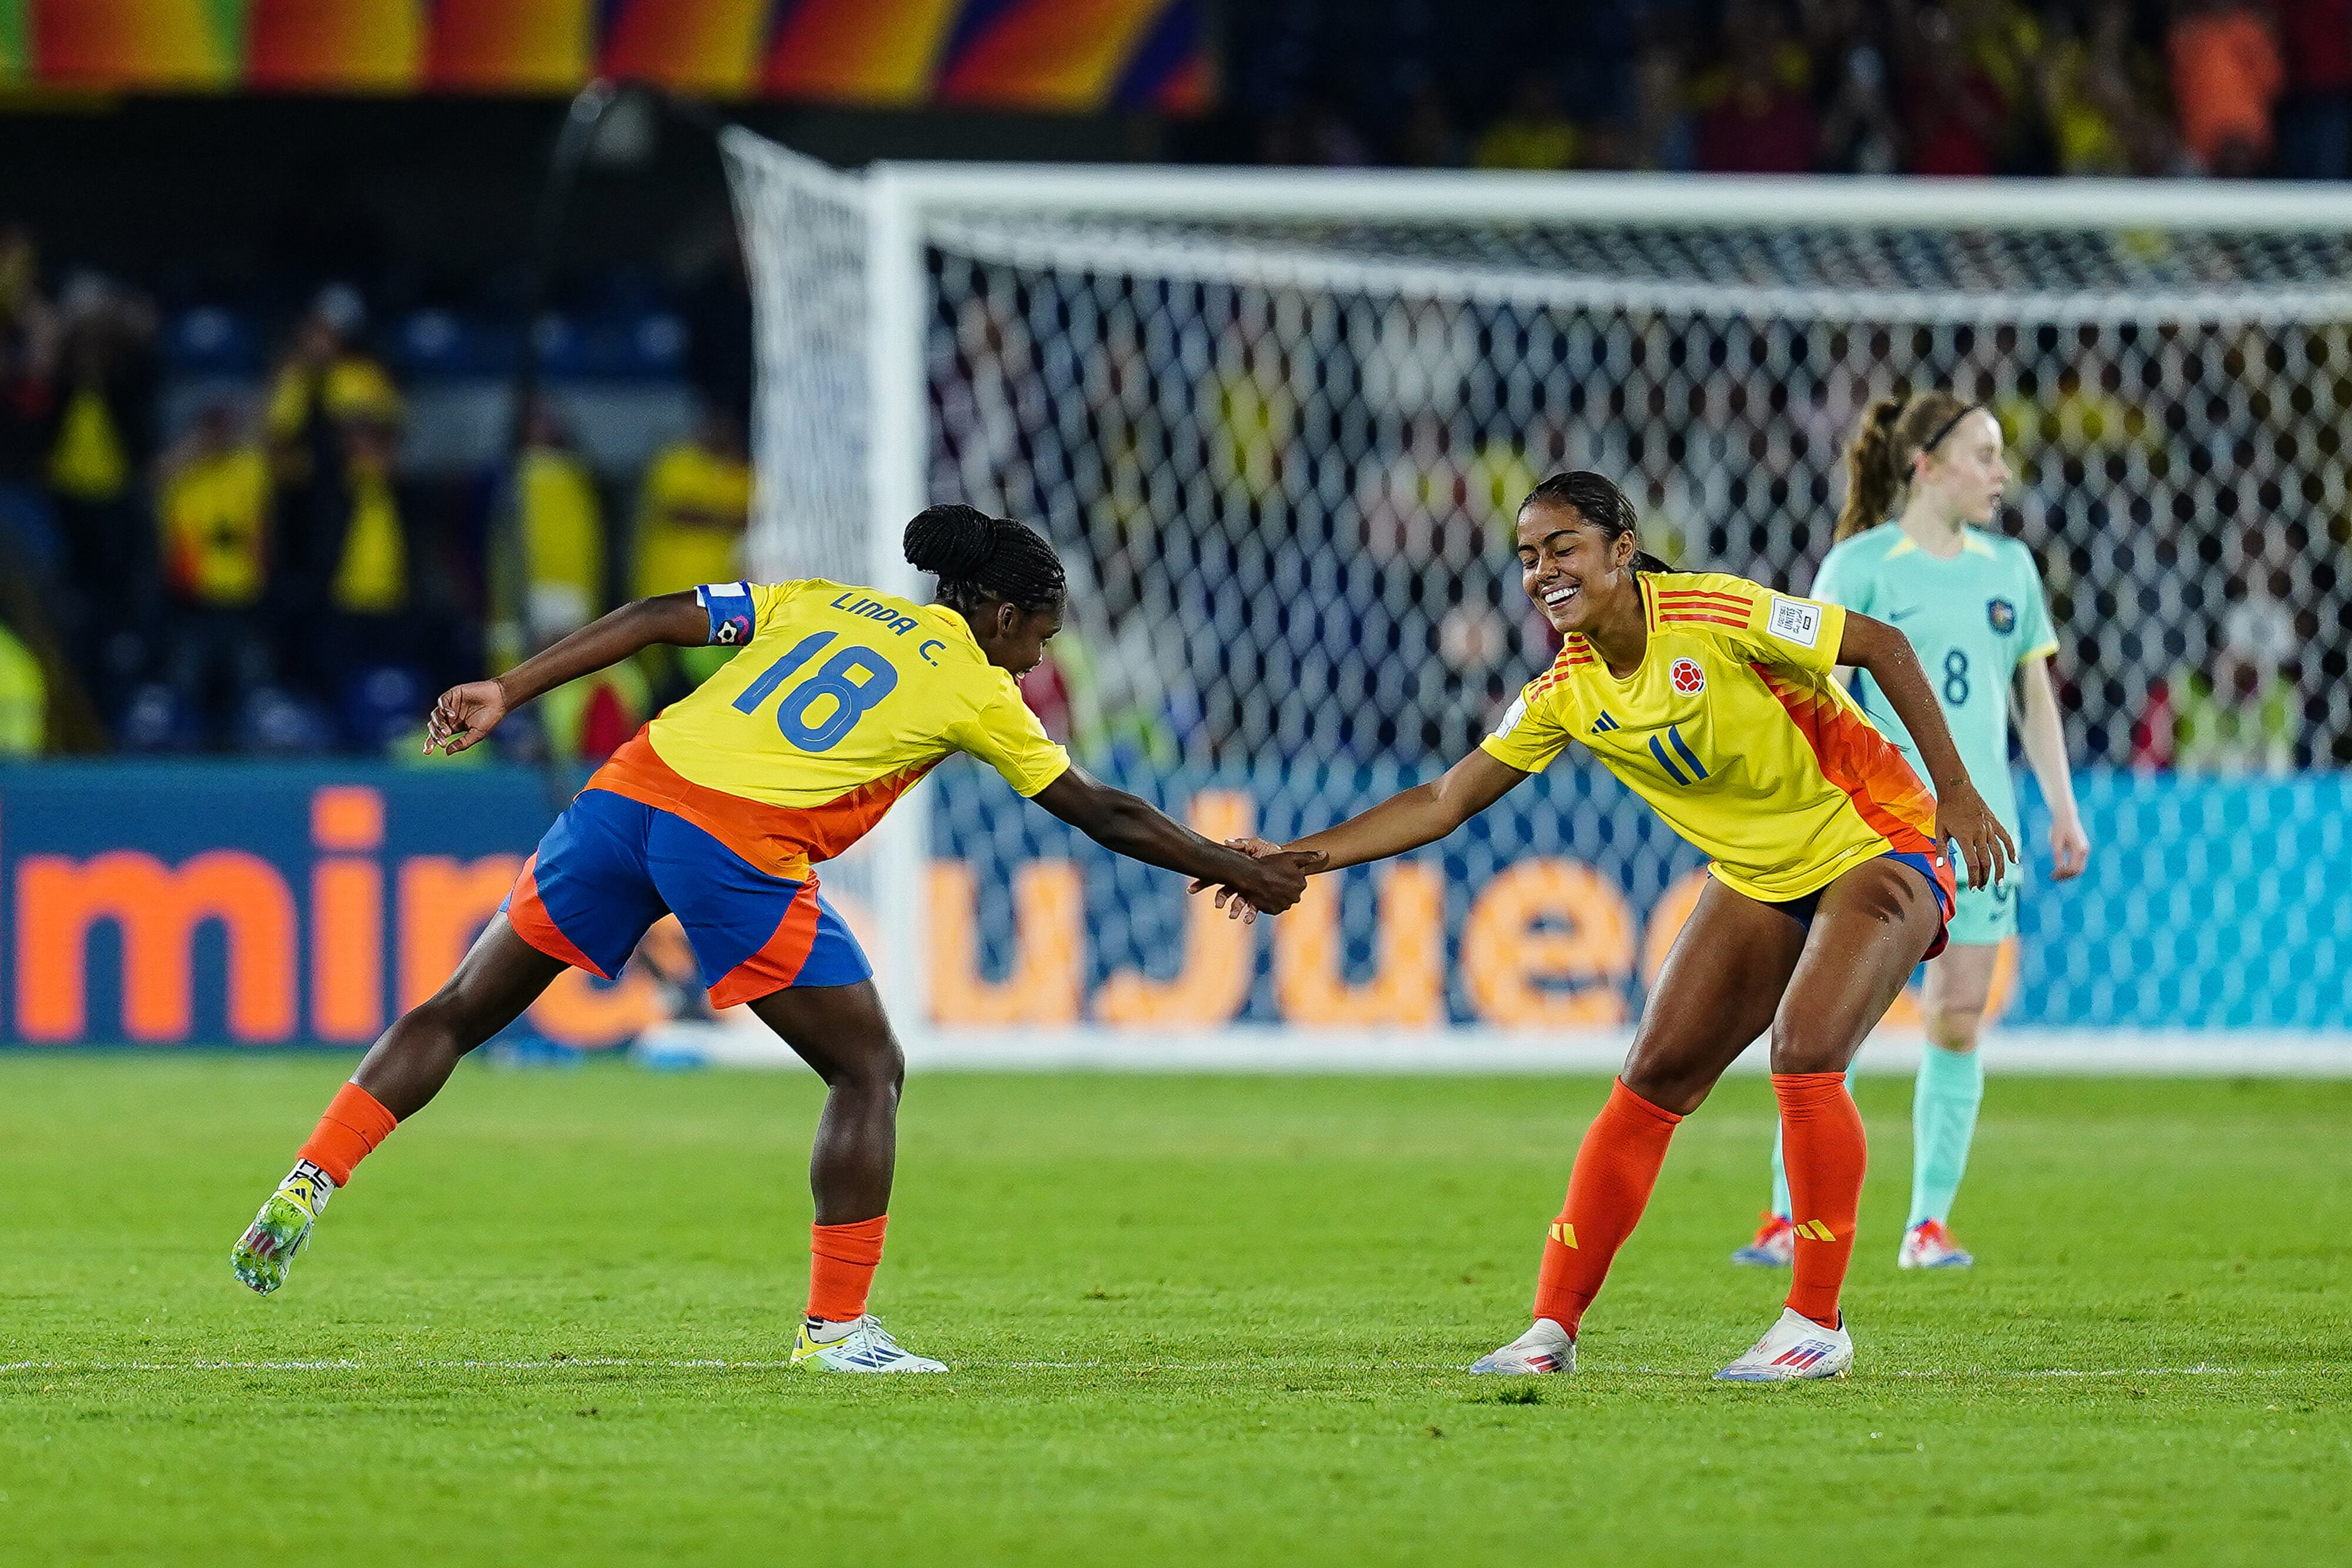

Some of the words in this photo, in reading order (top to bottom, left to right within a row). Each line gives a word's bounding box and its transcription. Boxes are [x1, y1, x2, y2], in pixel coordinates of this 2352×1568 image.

[830, 592, 918, 637] LINDA
[919, 639, 947, 667] C.
[731, 631, 898, 753] 18
[1944, 649, 1969, 706] 8
[1649, 724, 1710, 786] 11
